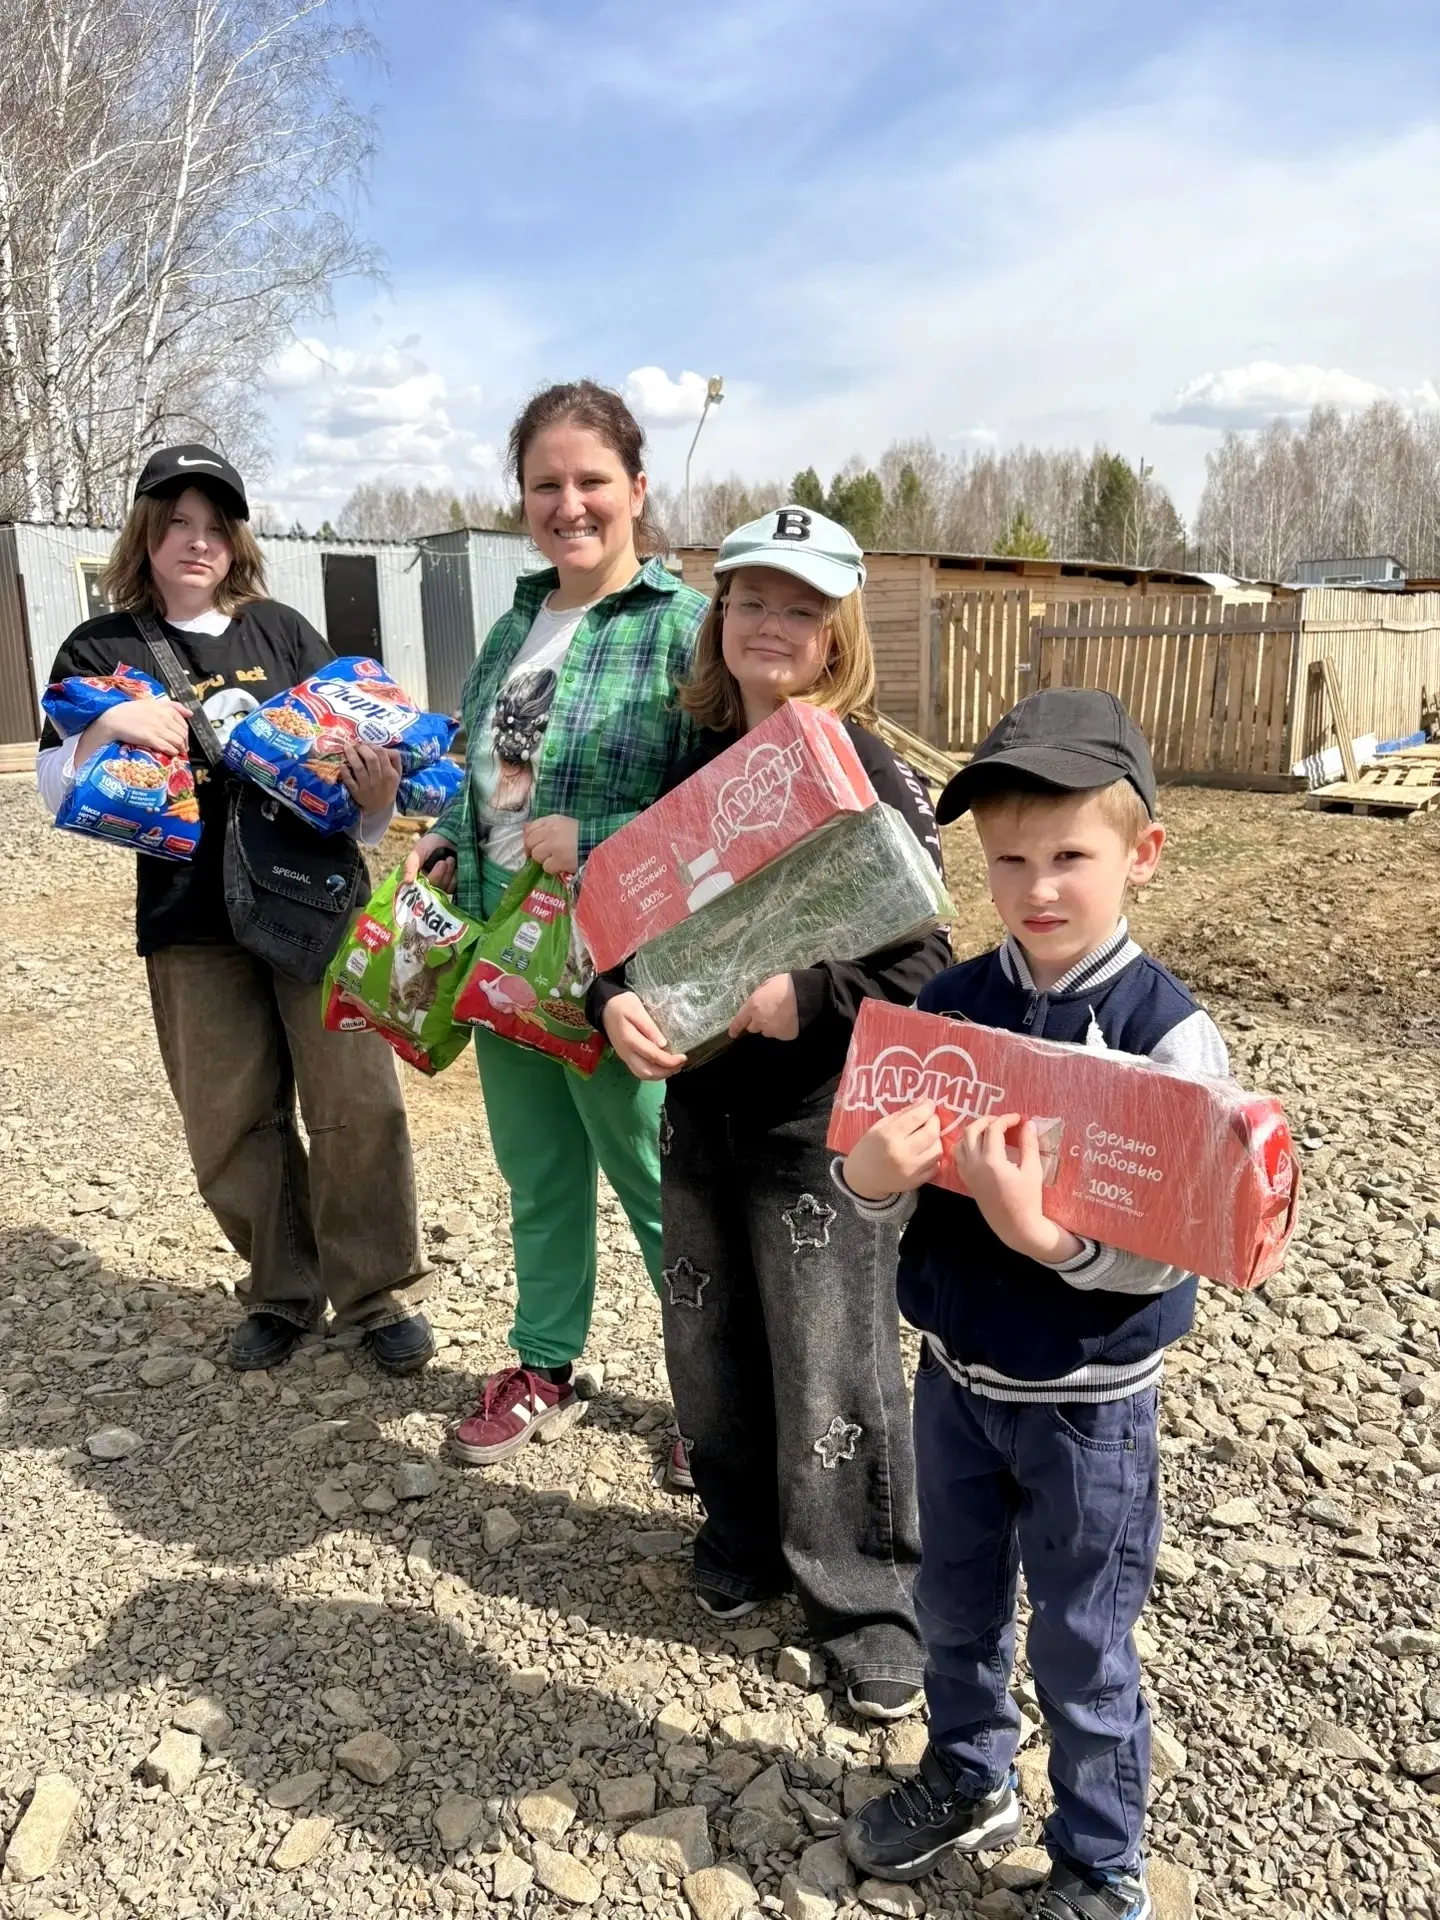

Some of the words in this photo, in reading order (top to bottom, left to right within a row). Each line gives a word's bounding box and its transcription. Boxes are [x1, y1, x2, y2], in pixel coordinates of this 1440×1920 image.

[773, 509, 813, 542] B
[101, 775, 127, 797] 100%
[711, 738, 804, 852] ДАРЛИНГ
[81, 804, 101, 816] Масса
[272, 865, 311, 884] SPECIAL
[619, 855, 657, 886] Сделано
[627, 864, 668, 898] любовью
[530, 889, 566, 910] МЯСНОЙ
[639, 888, 665, 911] 100%
[844, 1066, 1005, 1120] ДАРЛИНГ
[1085, 1122, 1157, 1157] Сделано
[1082, 1149, 1164, 1181] любовью
[1088, 1179, 1133, 1206] 100%
